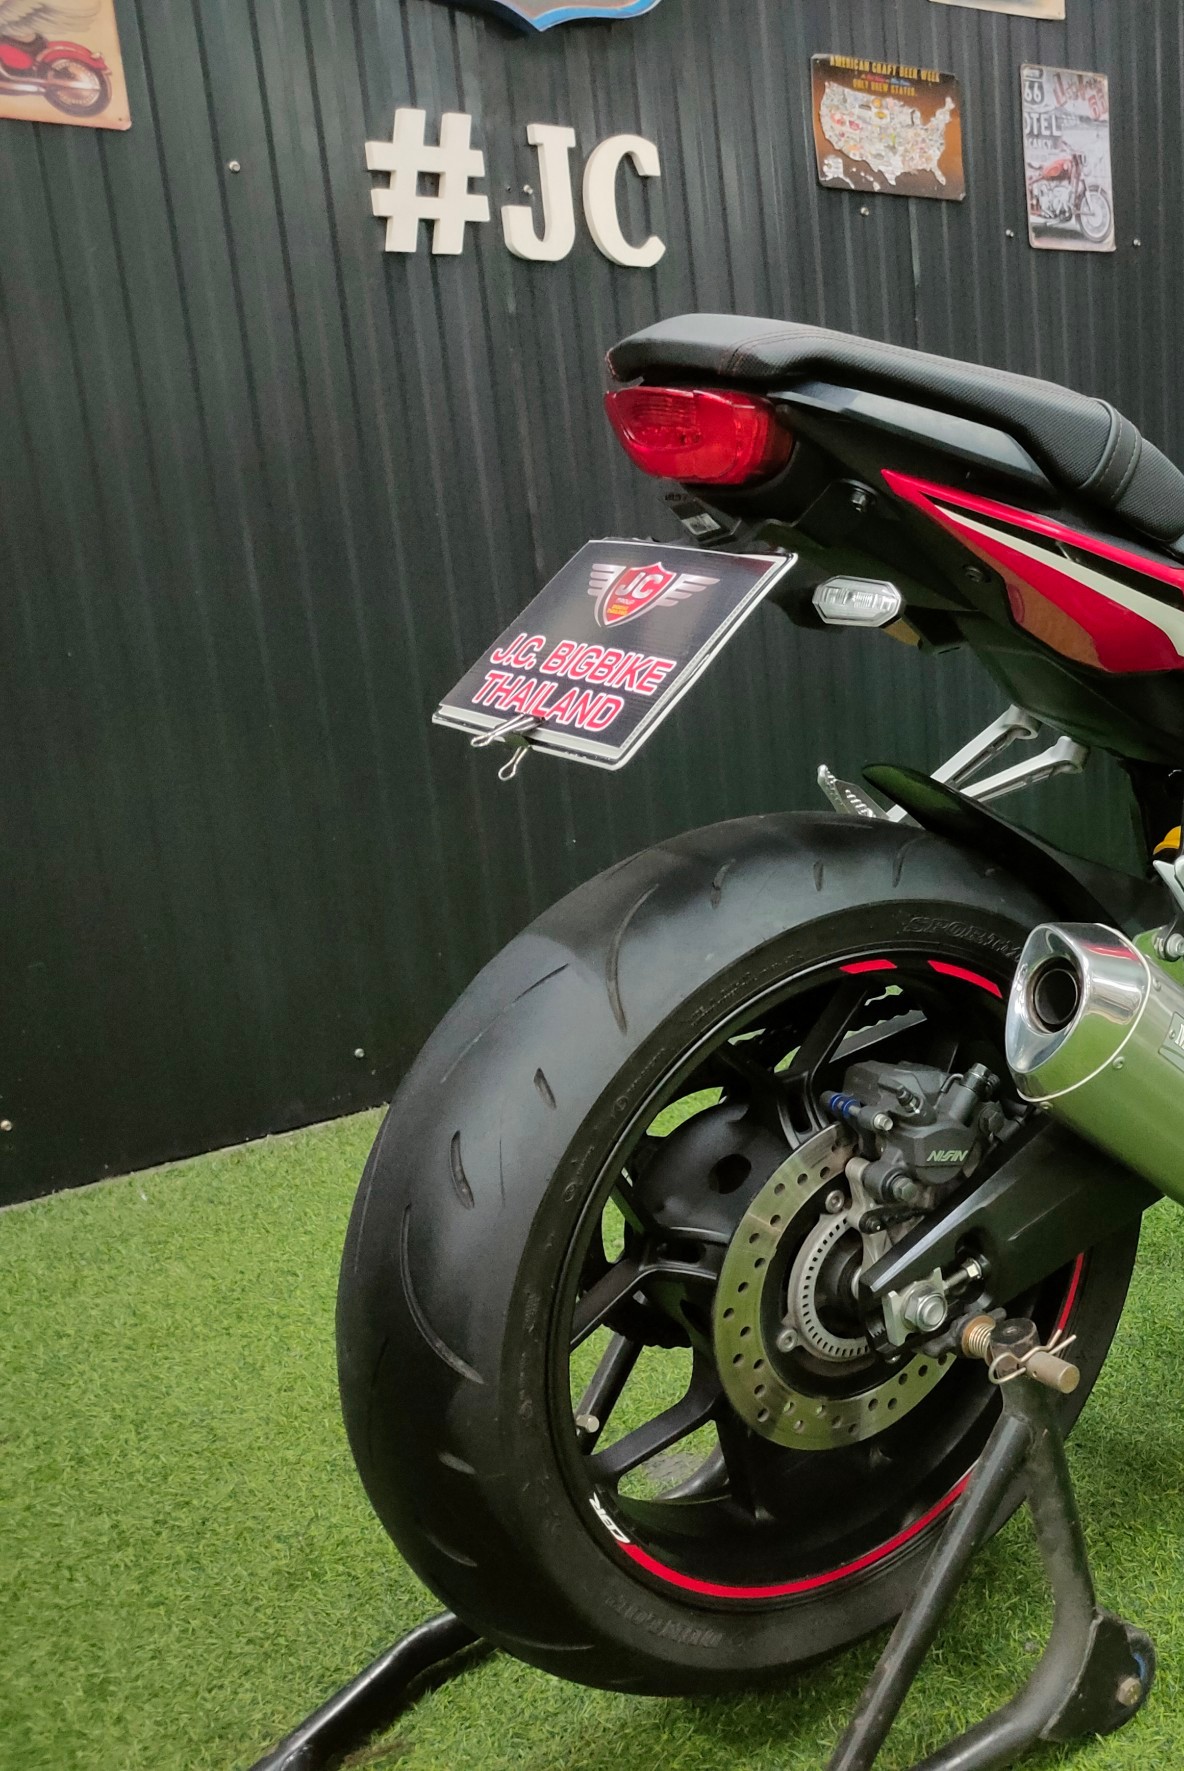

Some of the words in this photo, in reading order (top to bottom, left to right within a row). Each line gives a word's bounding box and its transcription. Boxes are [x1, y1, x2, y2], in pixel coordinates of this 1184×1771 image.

[830, 54, 869, 72] AMERICAN
[872, 61, 896, 76] CRAFT
[899, 65, 918, 80] BEER
[921, 69, 940, 83] WEEK
[1024, 81, 1041, 103] 66
[365, 108, 666, 268] #JC
[615, 572, 664, 599] JC
[490, 633, 546, 669] J.C.
[540, 640, 676, 694] BIGBIKE
[472, 670, 624, 732] THAILAND
